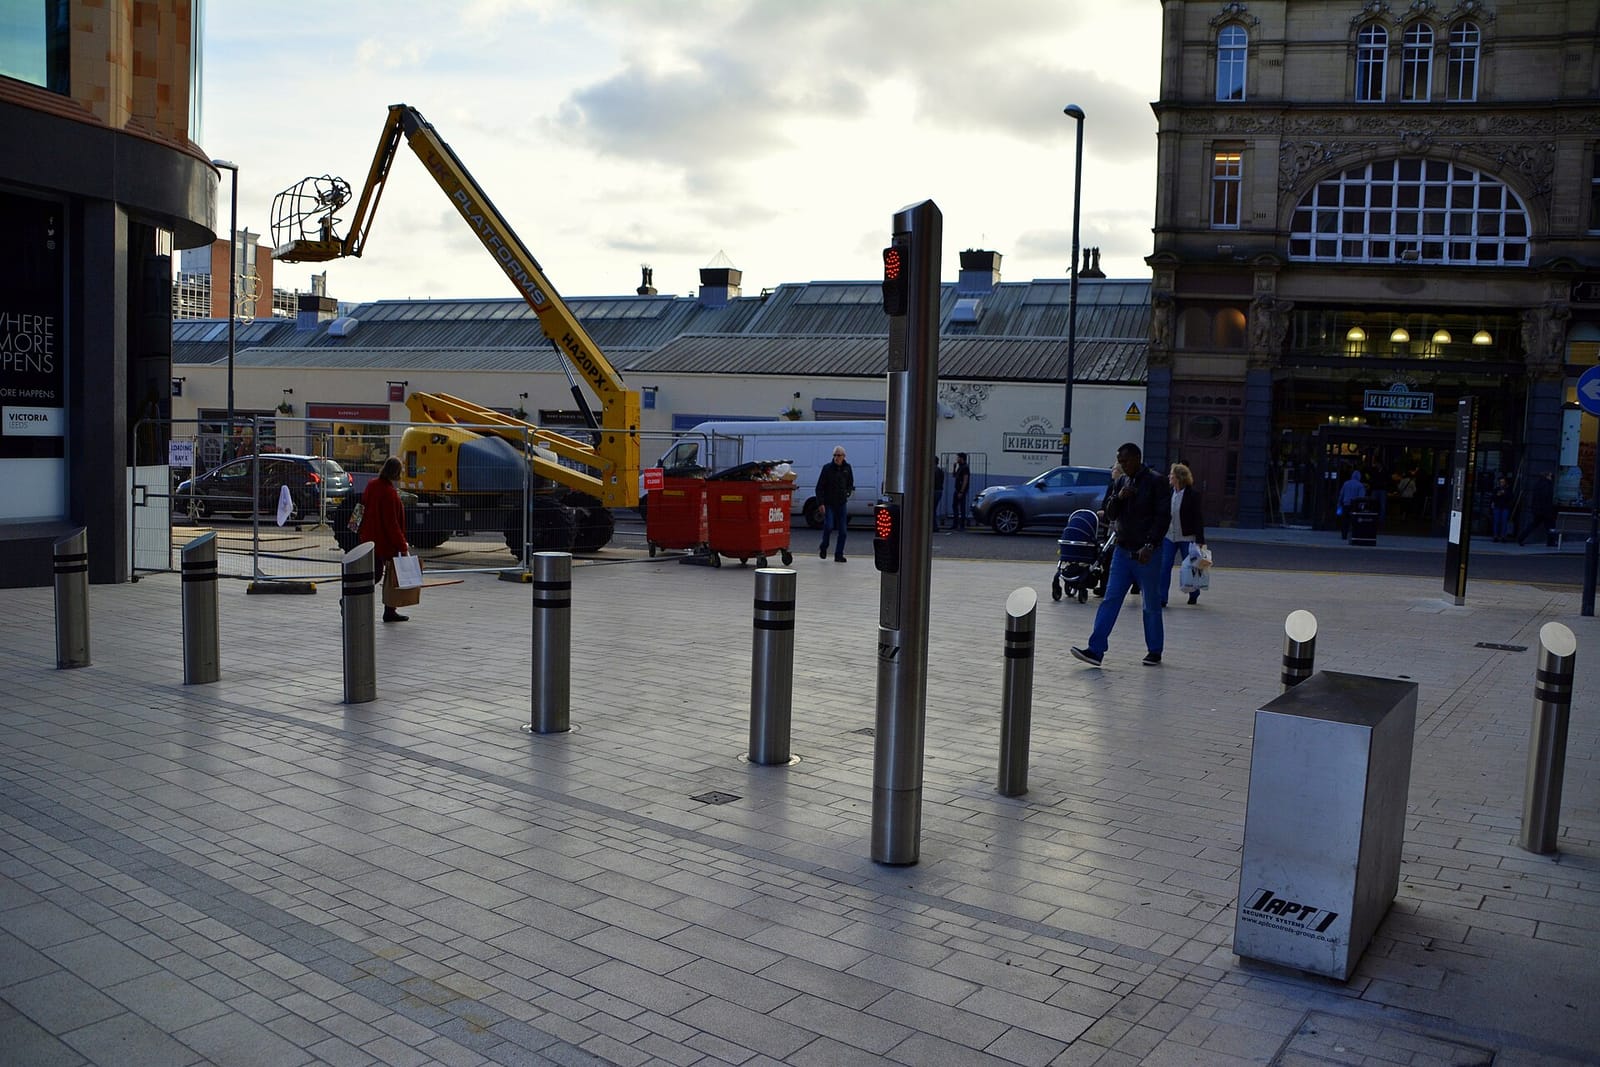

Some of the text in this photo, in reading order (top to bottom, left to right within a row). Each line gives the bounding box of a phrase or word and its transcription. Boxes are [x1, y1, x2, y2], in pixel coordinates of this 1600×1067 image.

[454, 189, 546, 306] PLATFORMS
[0, 311, 55, 335] HERE
[0, 351, 54, 374] PENS
[562, 333, 607, 389] HA20PX
[19, 388, 55, 399] HAPPENS
[1369, 394, 1429, 409] KIRKGATE
[9, 413, 48, 422] VICTORIA
[1008, 437, 1063, 450] KIRKGATE
[1242, 909, 1304, 928] SECURITY SYSTEMS
